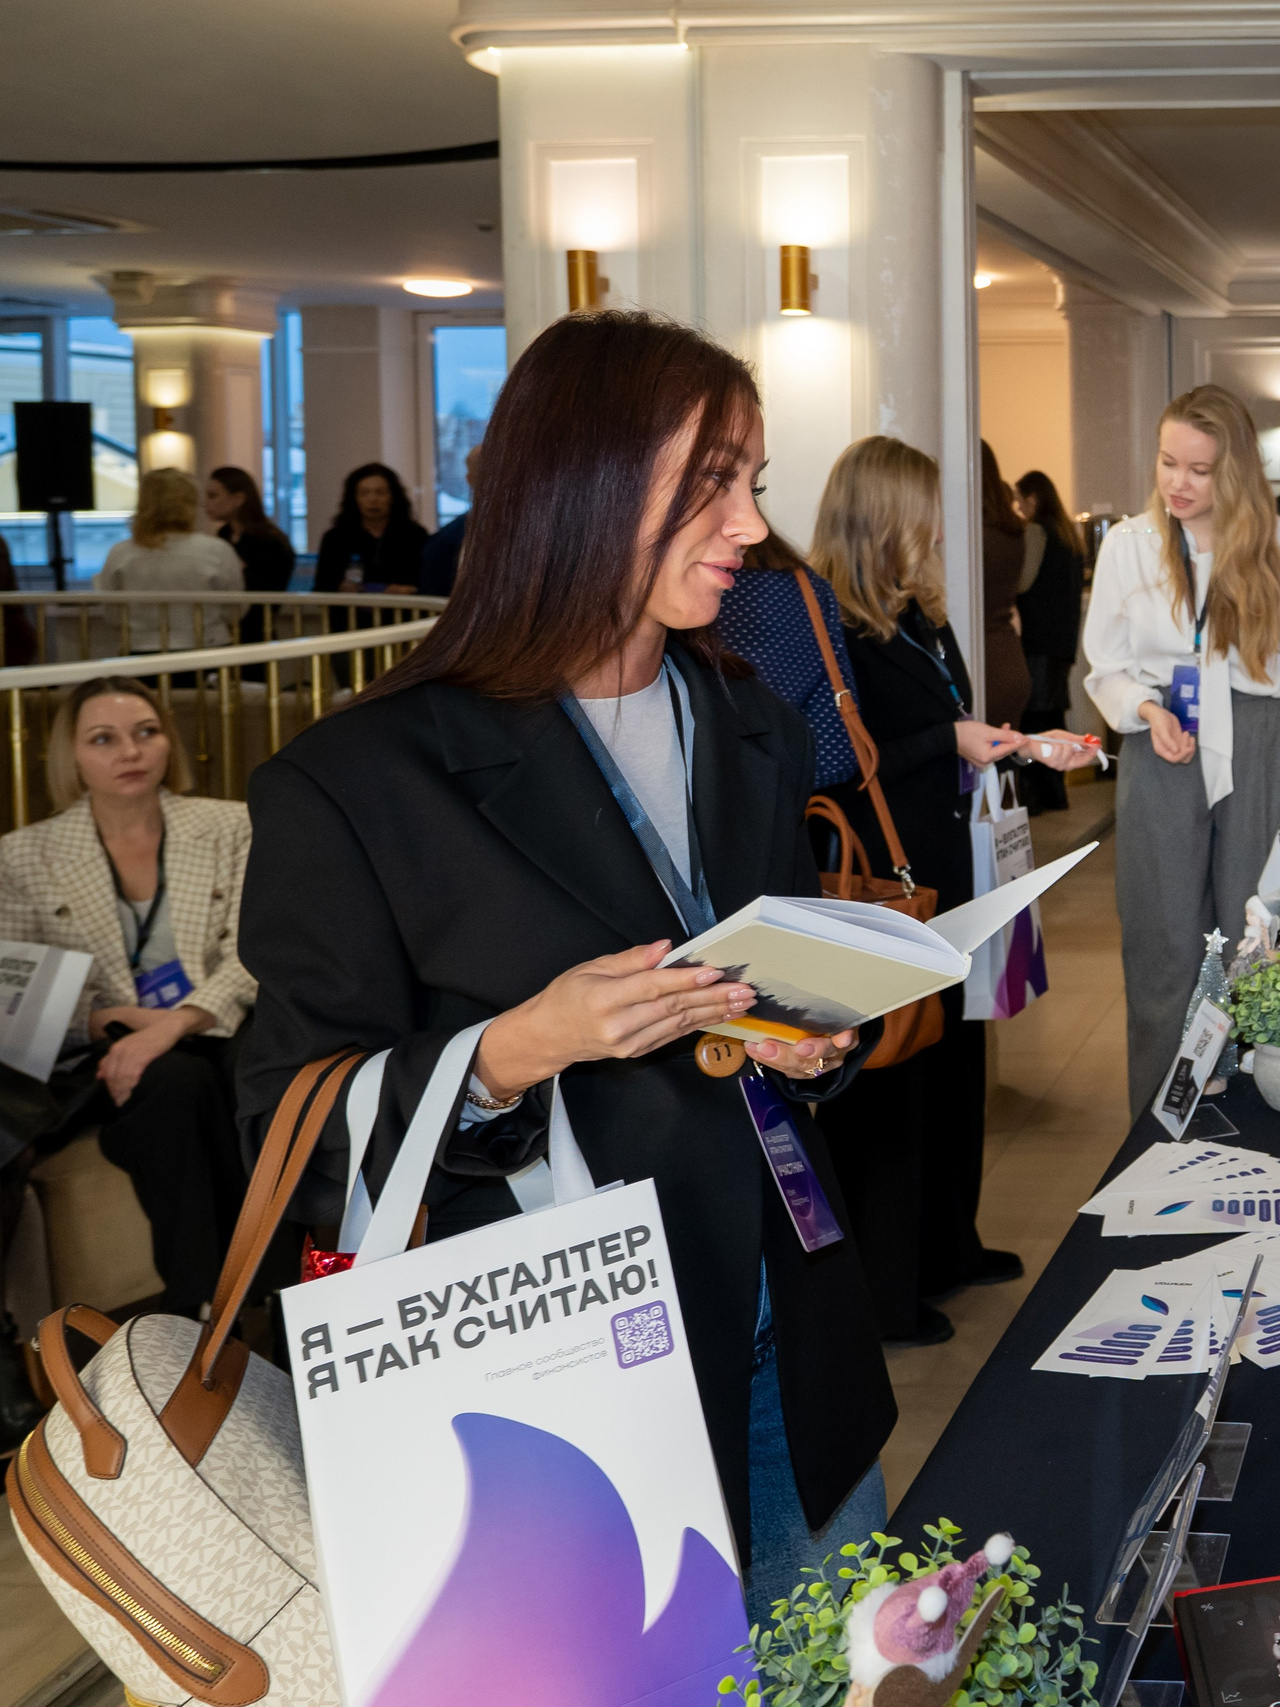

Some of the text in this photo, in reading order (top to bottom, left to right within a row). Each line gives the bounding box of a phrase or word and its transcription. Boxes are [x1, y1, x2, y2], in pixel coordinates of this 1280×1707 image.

[301, 1322, 333, 1361] Я
[397, 1224, 652, 1331] БУХГАЛТЕР
[307, 1258, 660, 1400] Я ТАК СЧИТАЮ!
[485, 1336, 606, 1382] Главное сообщество
[532, 1349, 608, 1381] финансистов
